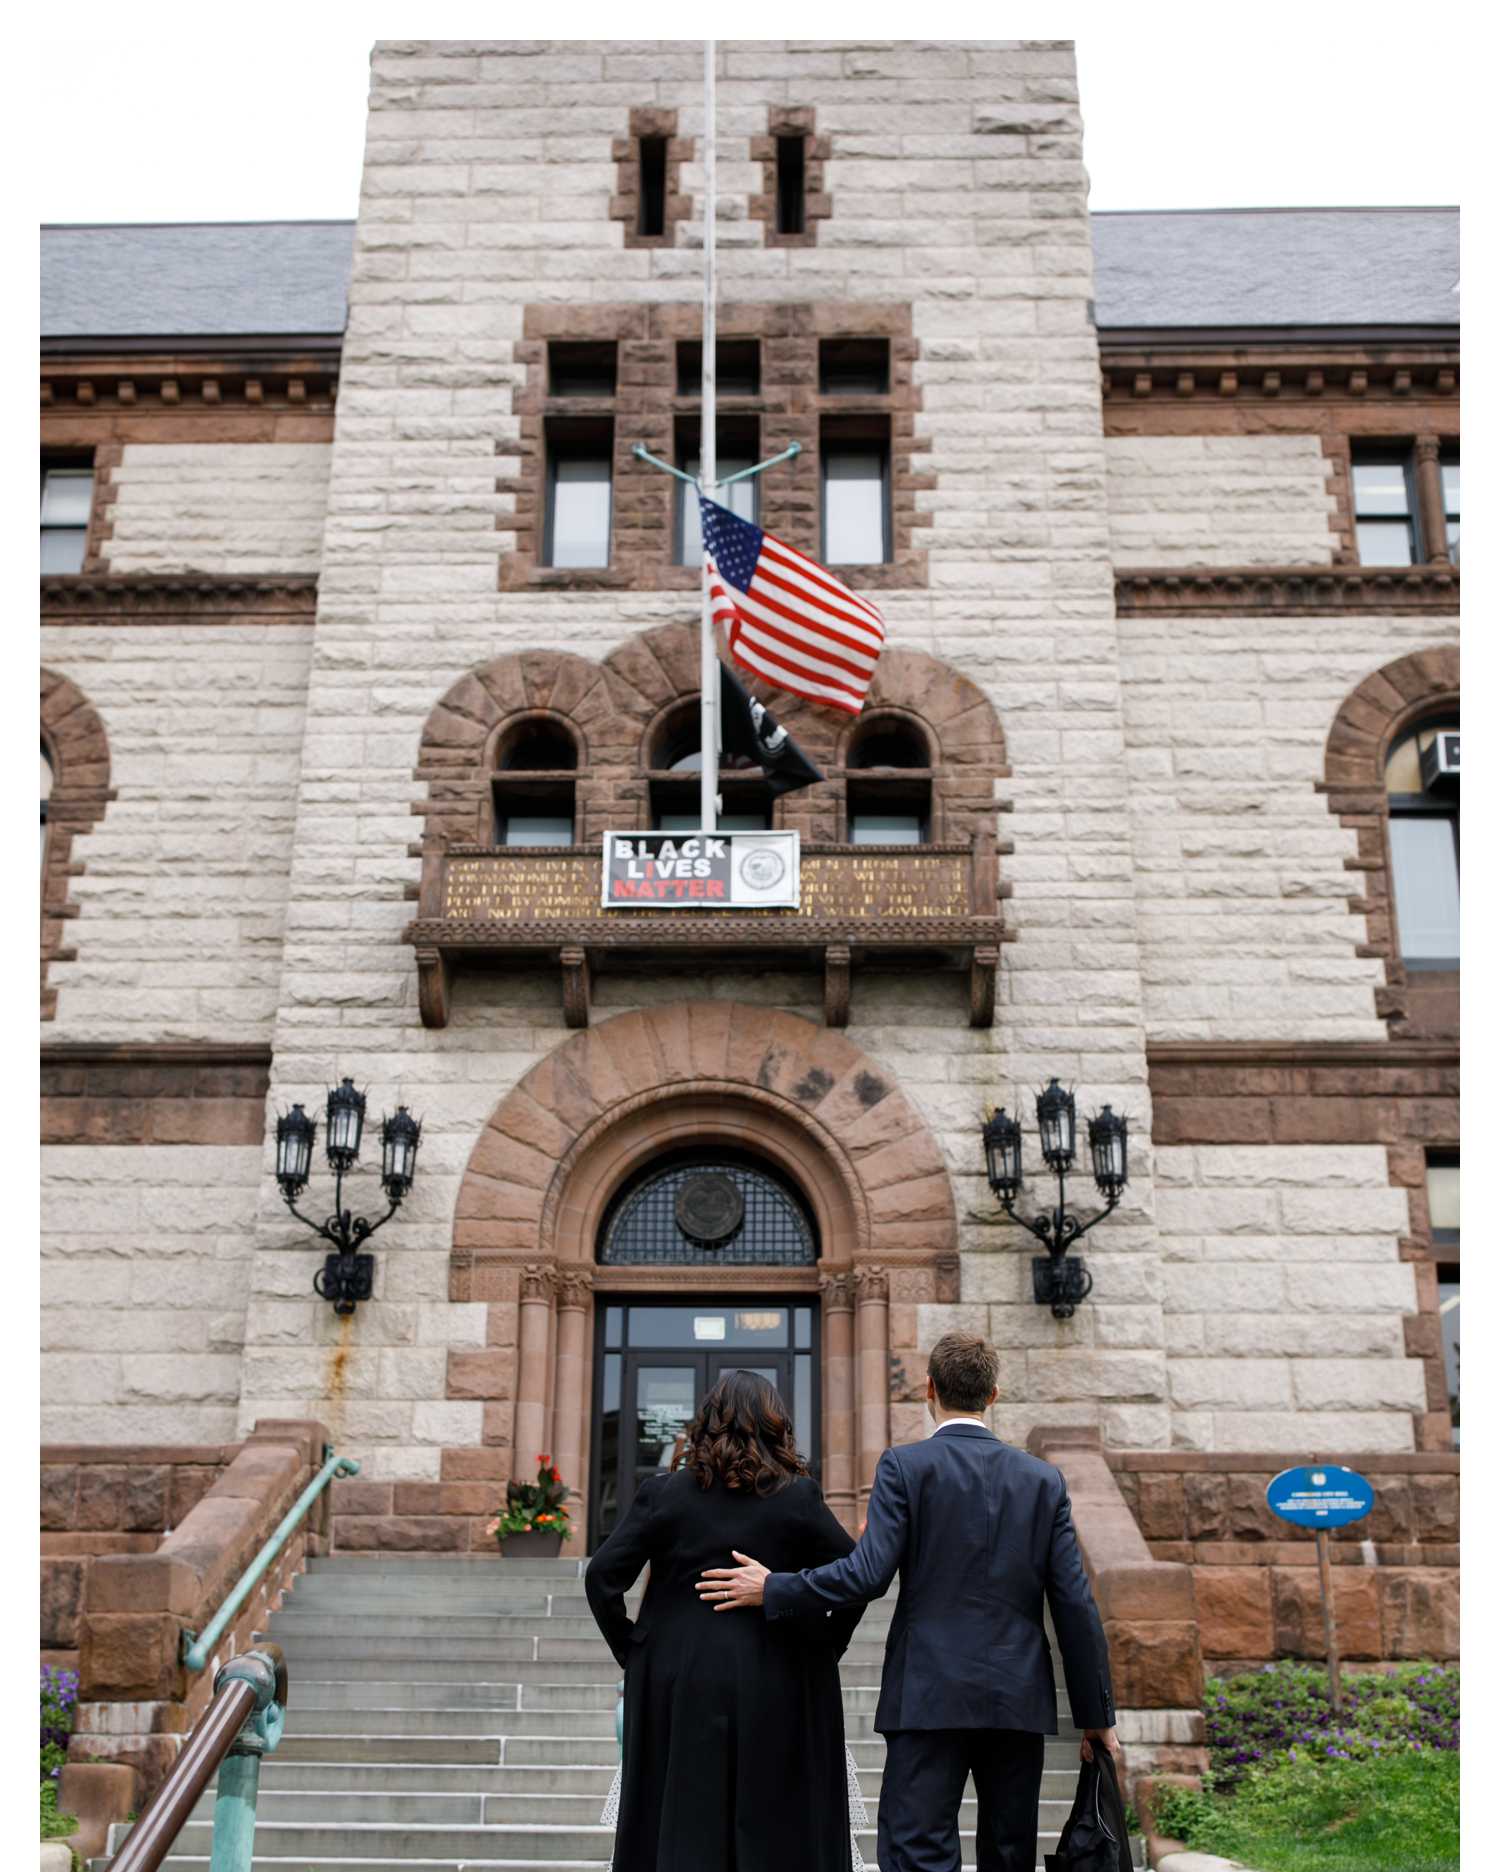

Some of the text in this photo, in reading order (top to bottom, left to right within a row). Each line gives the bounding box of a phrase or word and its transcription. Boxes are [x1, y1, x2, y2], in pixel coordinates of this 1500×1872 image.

[615, 839, 726, 859] BLACK
[628, 859, 711, 879] LIVES
[613, 879, 724, 897] MATTER
